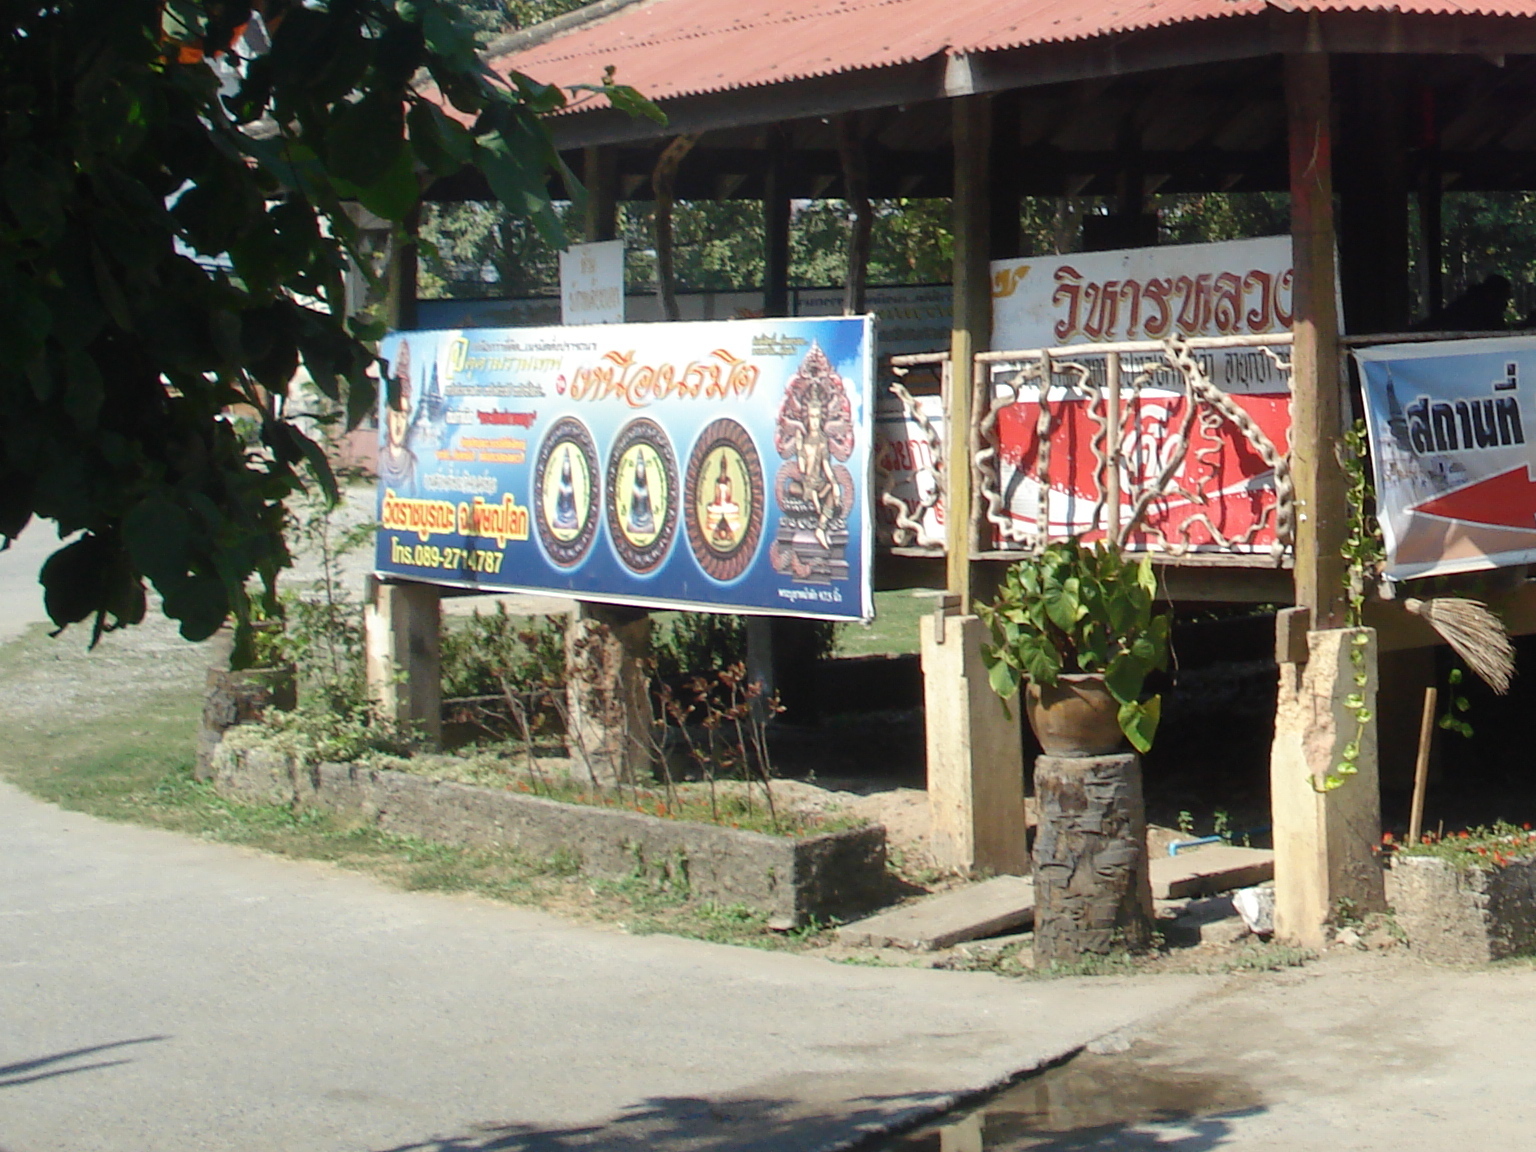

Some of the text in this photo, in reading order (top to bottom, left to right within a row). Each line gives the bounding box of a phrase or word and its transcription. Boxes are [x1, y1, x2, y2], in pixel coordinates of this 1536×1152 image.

[1052, 265, 1294, 342] วิหารหลวง
[1406, 363, 1524, 454] สถานที่
[382, 488, 529, 549] วัดราชบูรณะ จ.พิษณุโลก
